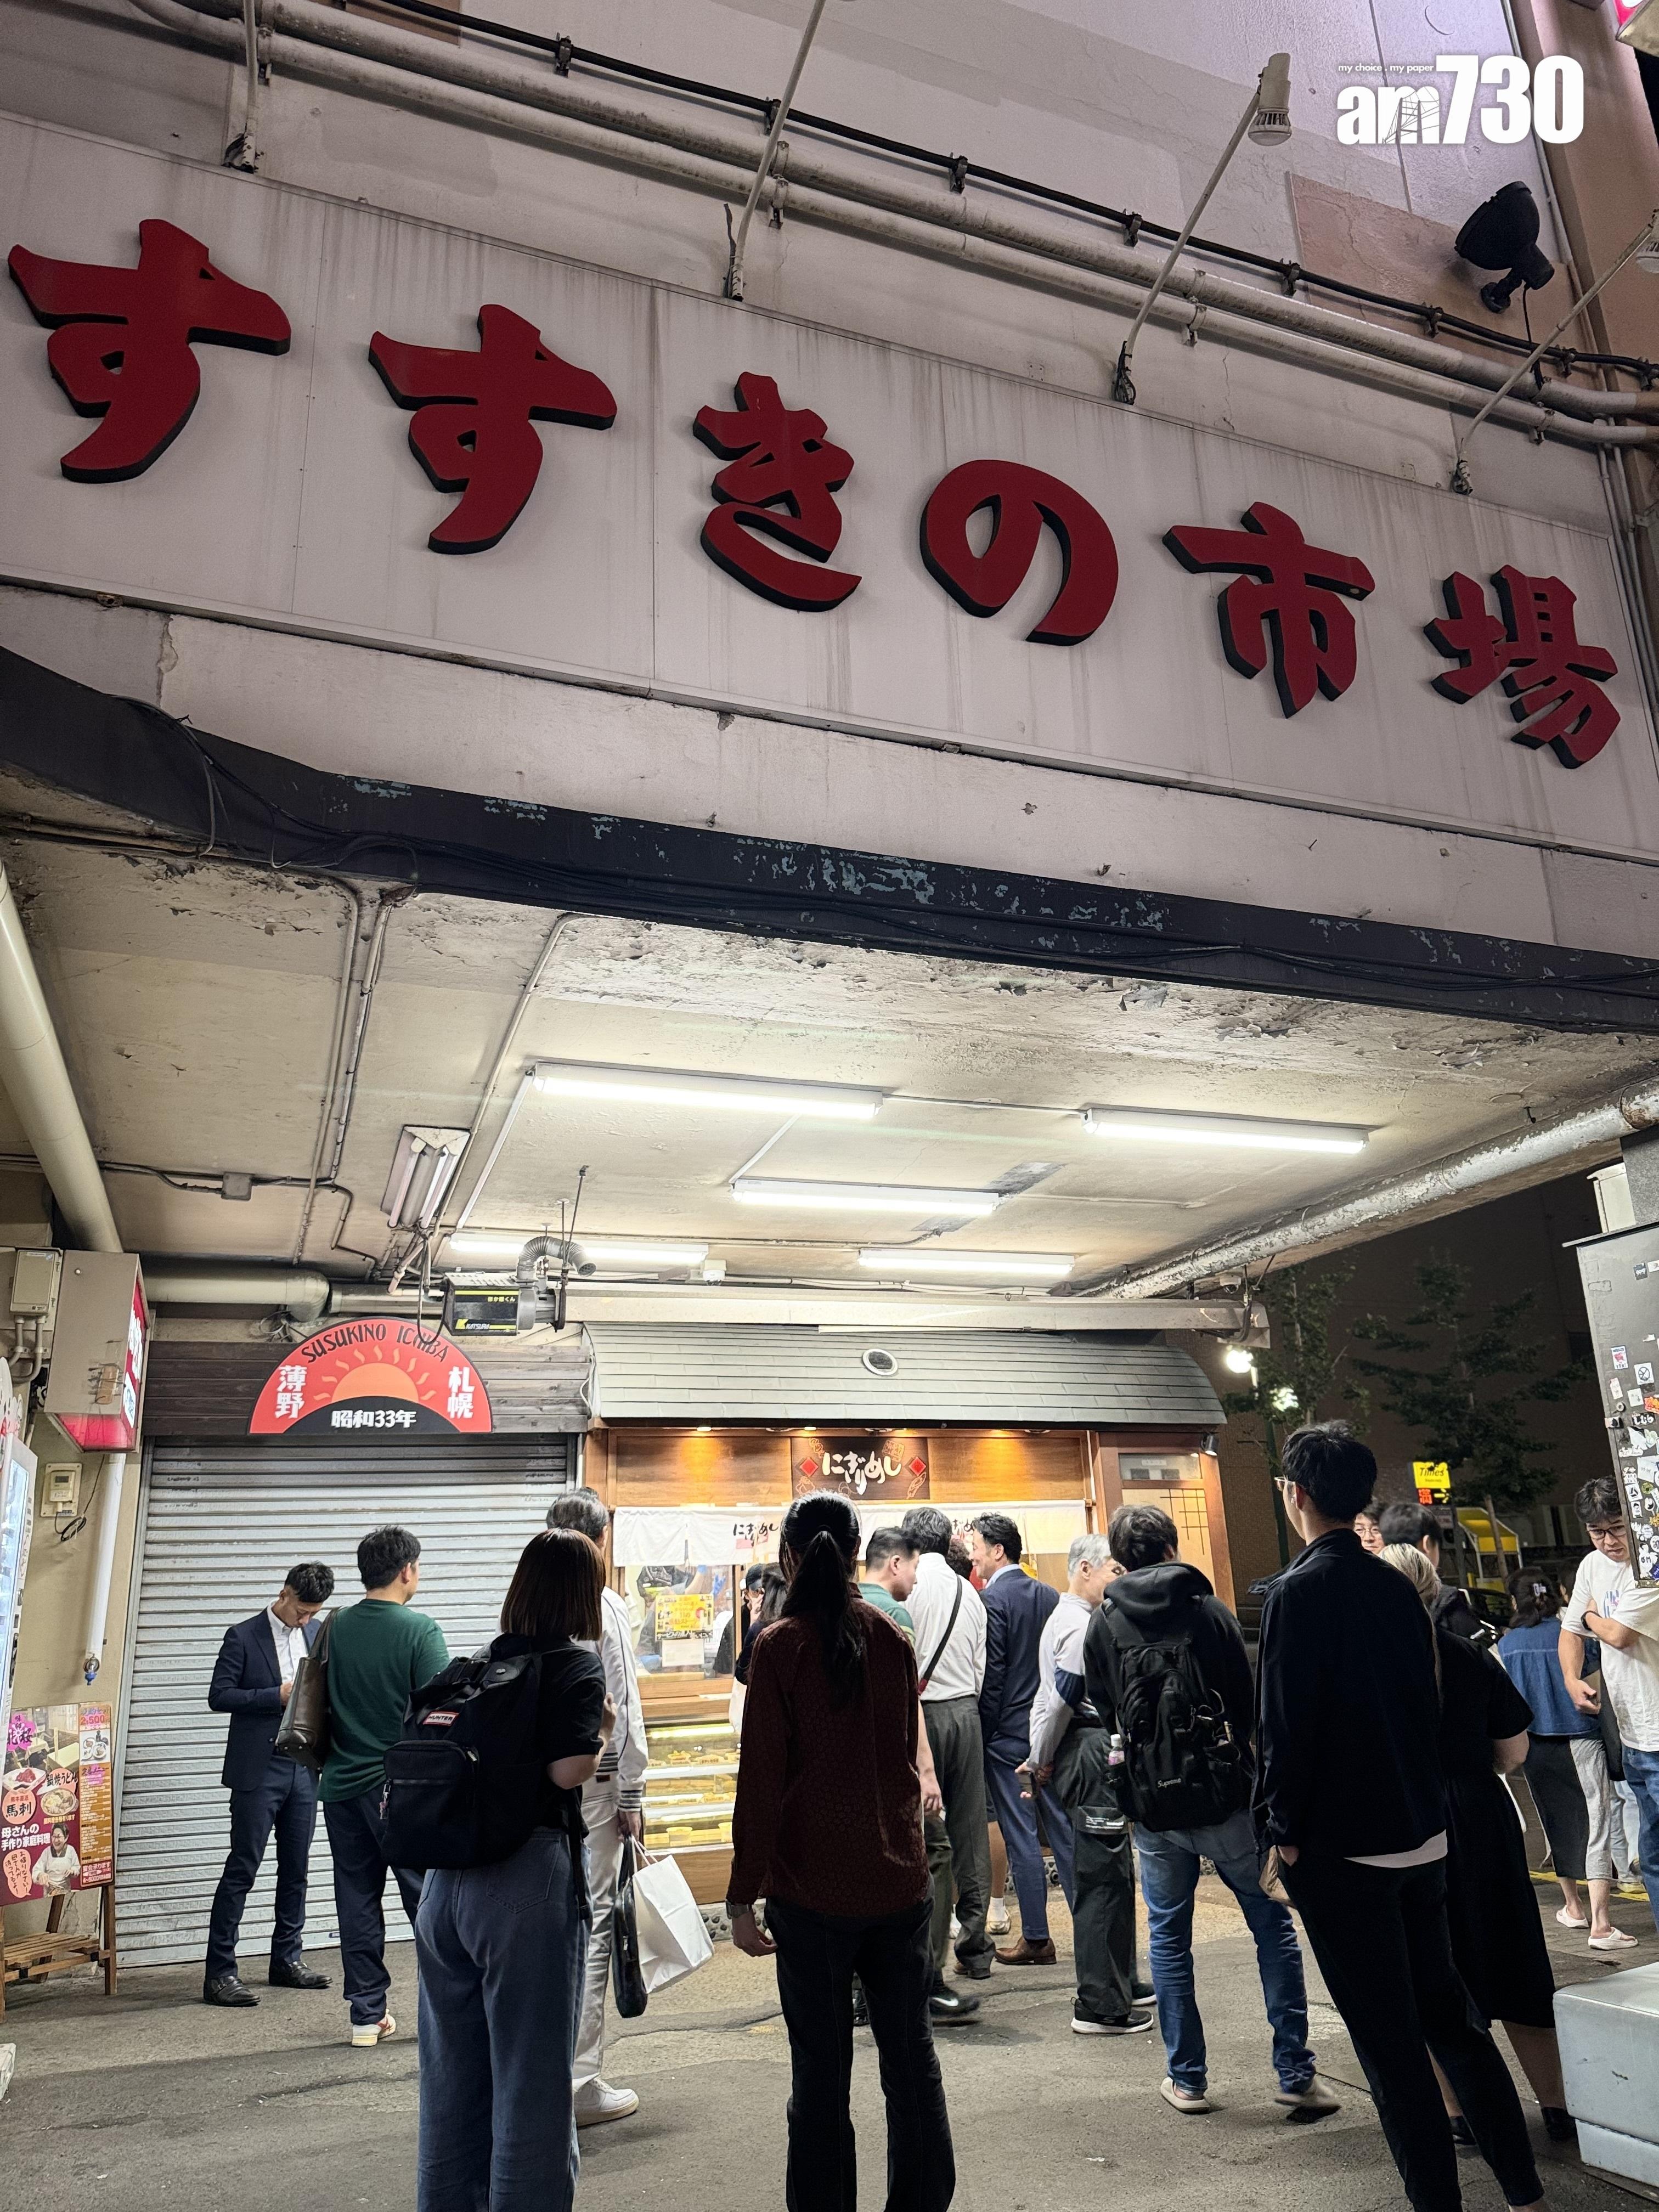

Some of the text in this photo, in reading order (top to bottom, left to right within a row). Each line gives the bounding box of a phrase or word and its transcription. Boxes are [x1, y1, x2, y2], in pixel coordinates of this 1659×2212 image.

[8, 218, 1622, 769] すすきの市場
[301, 1323, 387, 1364] SUSUKINO
[275, 1364, 307, 1419] 薄野
[447, 1366, 475, 1419] 札幌
[331, 1409, 417, 1429] 昭和33年
[822, 1451, 902, 1496] にぎりめし
[5, 1802, 32, 1818] 馬刺
[1, 1832, 51, 1852] 手作り家庭料理
[2, 1823, 40, 1839] 母さんの
